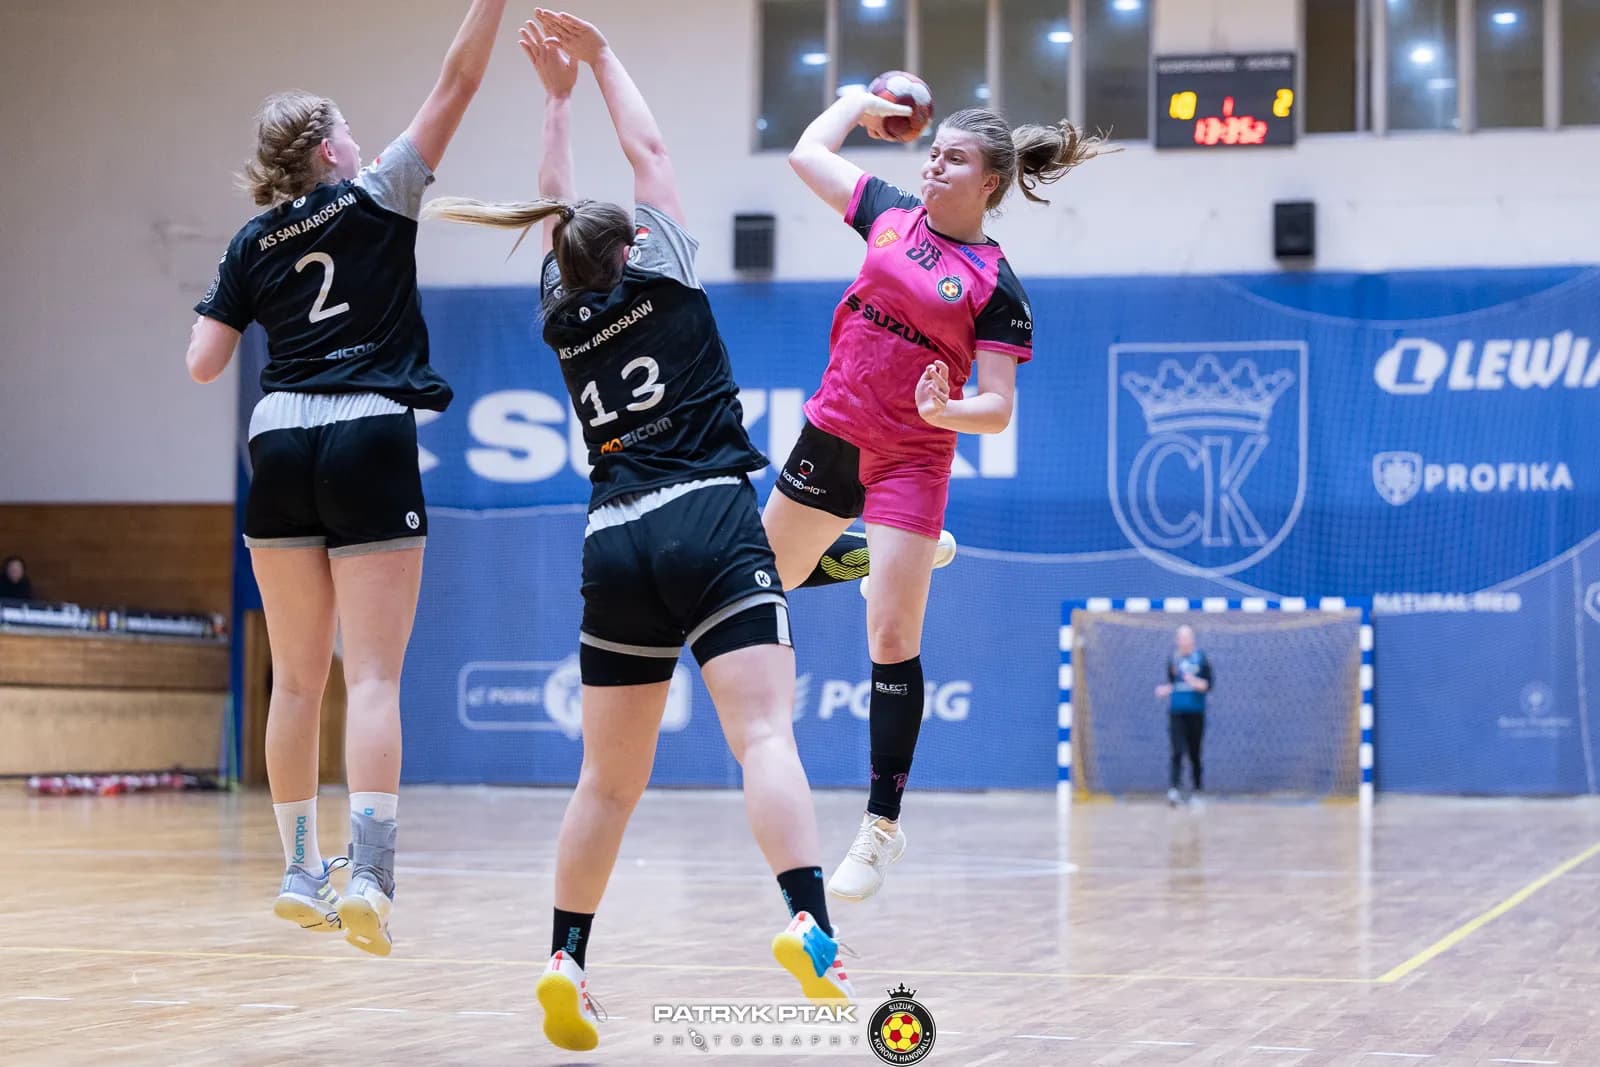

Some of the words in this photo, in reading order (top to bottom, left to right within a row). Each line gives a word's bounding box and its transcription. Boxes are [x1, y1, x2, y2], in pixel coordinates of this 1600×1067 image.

[259, 233, 278, 251] JKS
[276, 223, 301, 242] SAN
[301, 192, 357, 233] JAROSŁAW
[294, 251, 350, 324] 2
[592, 300, 654, 348] JAROSŁAW
[862, 304, 940, 353] SUZUK
[1010, 319, 1033, 330] PRO
[580, 356, 666, 427] 13
[1424, 462, 1574, 492] PROFIKA
[875, 682, 908, 692] SELECT
[292, 815, 307, 864] Kempa
[561, 927, 581, 953] empa
